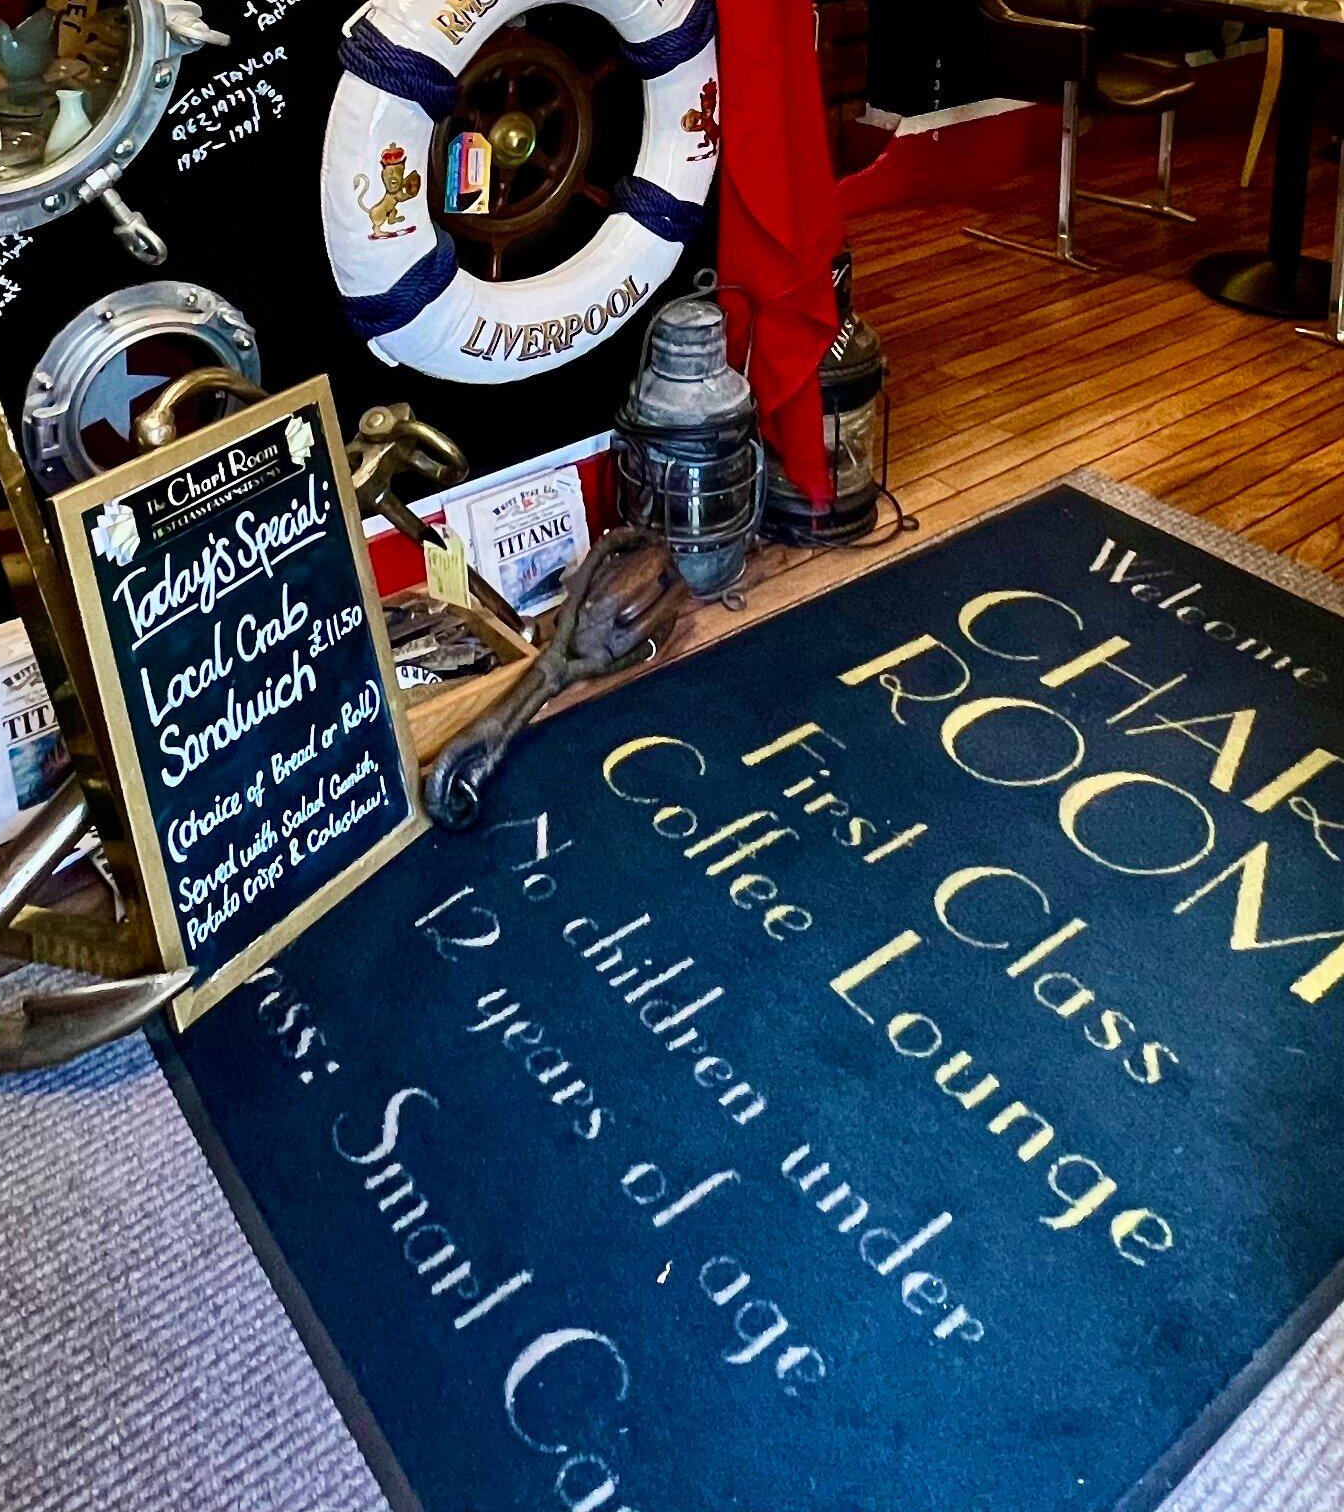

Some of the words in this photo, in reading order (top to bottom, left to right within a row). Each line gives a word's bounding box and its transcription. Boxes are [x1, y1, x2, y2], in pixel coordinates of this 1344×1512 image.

[167, 82, 216, 115] JON
[459, 275, 650, 363] LIVERPOOL
[147, 497, 166, 516] The
[167, 462, 226, 507] Chart
[228, 443, 279, 477] Room
[494, 513, 573, 559] TITANIC
[113, 533, 236, 639] Today's
[236, 473, 332, 581] Special:
[1089, 534, 1330, 688] Welcome
[141, 621, 234, 727] Local
[237, 582, 308, 663] Crab
[159, 649, 317, 788] Sandwich
[247, 769, 266, 807] of
[270, 723, 318, 785] Bread
[321, 722, 338, 749] or
[340, 679, 381, 735] Roll)
[179, 843, 239, 913] Served
[239, 819, 279, 868] with
[281, 777, 326, 838] Salad
[186, 883, 241, 951] Potato
[289, 837, 306, 867] &
[307, 775, 390, 854] Coleslaw!
[741, 720, 930, 866] First
[932, 864, 1180, 1085] Class
[602, 735, 814, 944] Coffee
[830, 929, 1175, 1267] Lounge
[488, 812, 573, 903] No
[562, 910, 770, 1126] children
[781, 1142, 985, 1343] under
[332, 1086, 535, 1330] Smart
[466, 986, 616, 1143] years
[621, 1161, 741, 1228] of
[699, 1254, 827, 1398] age
